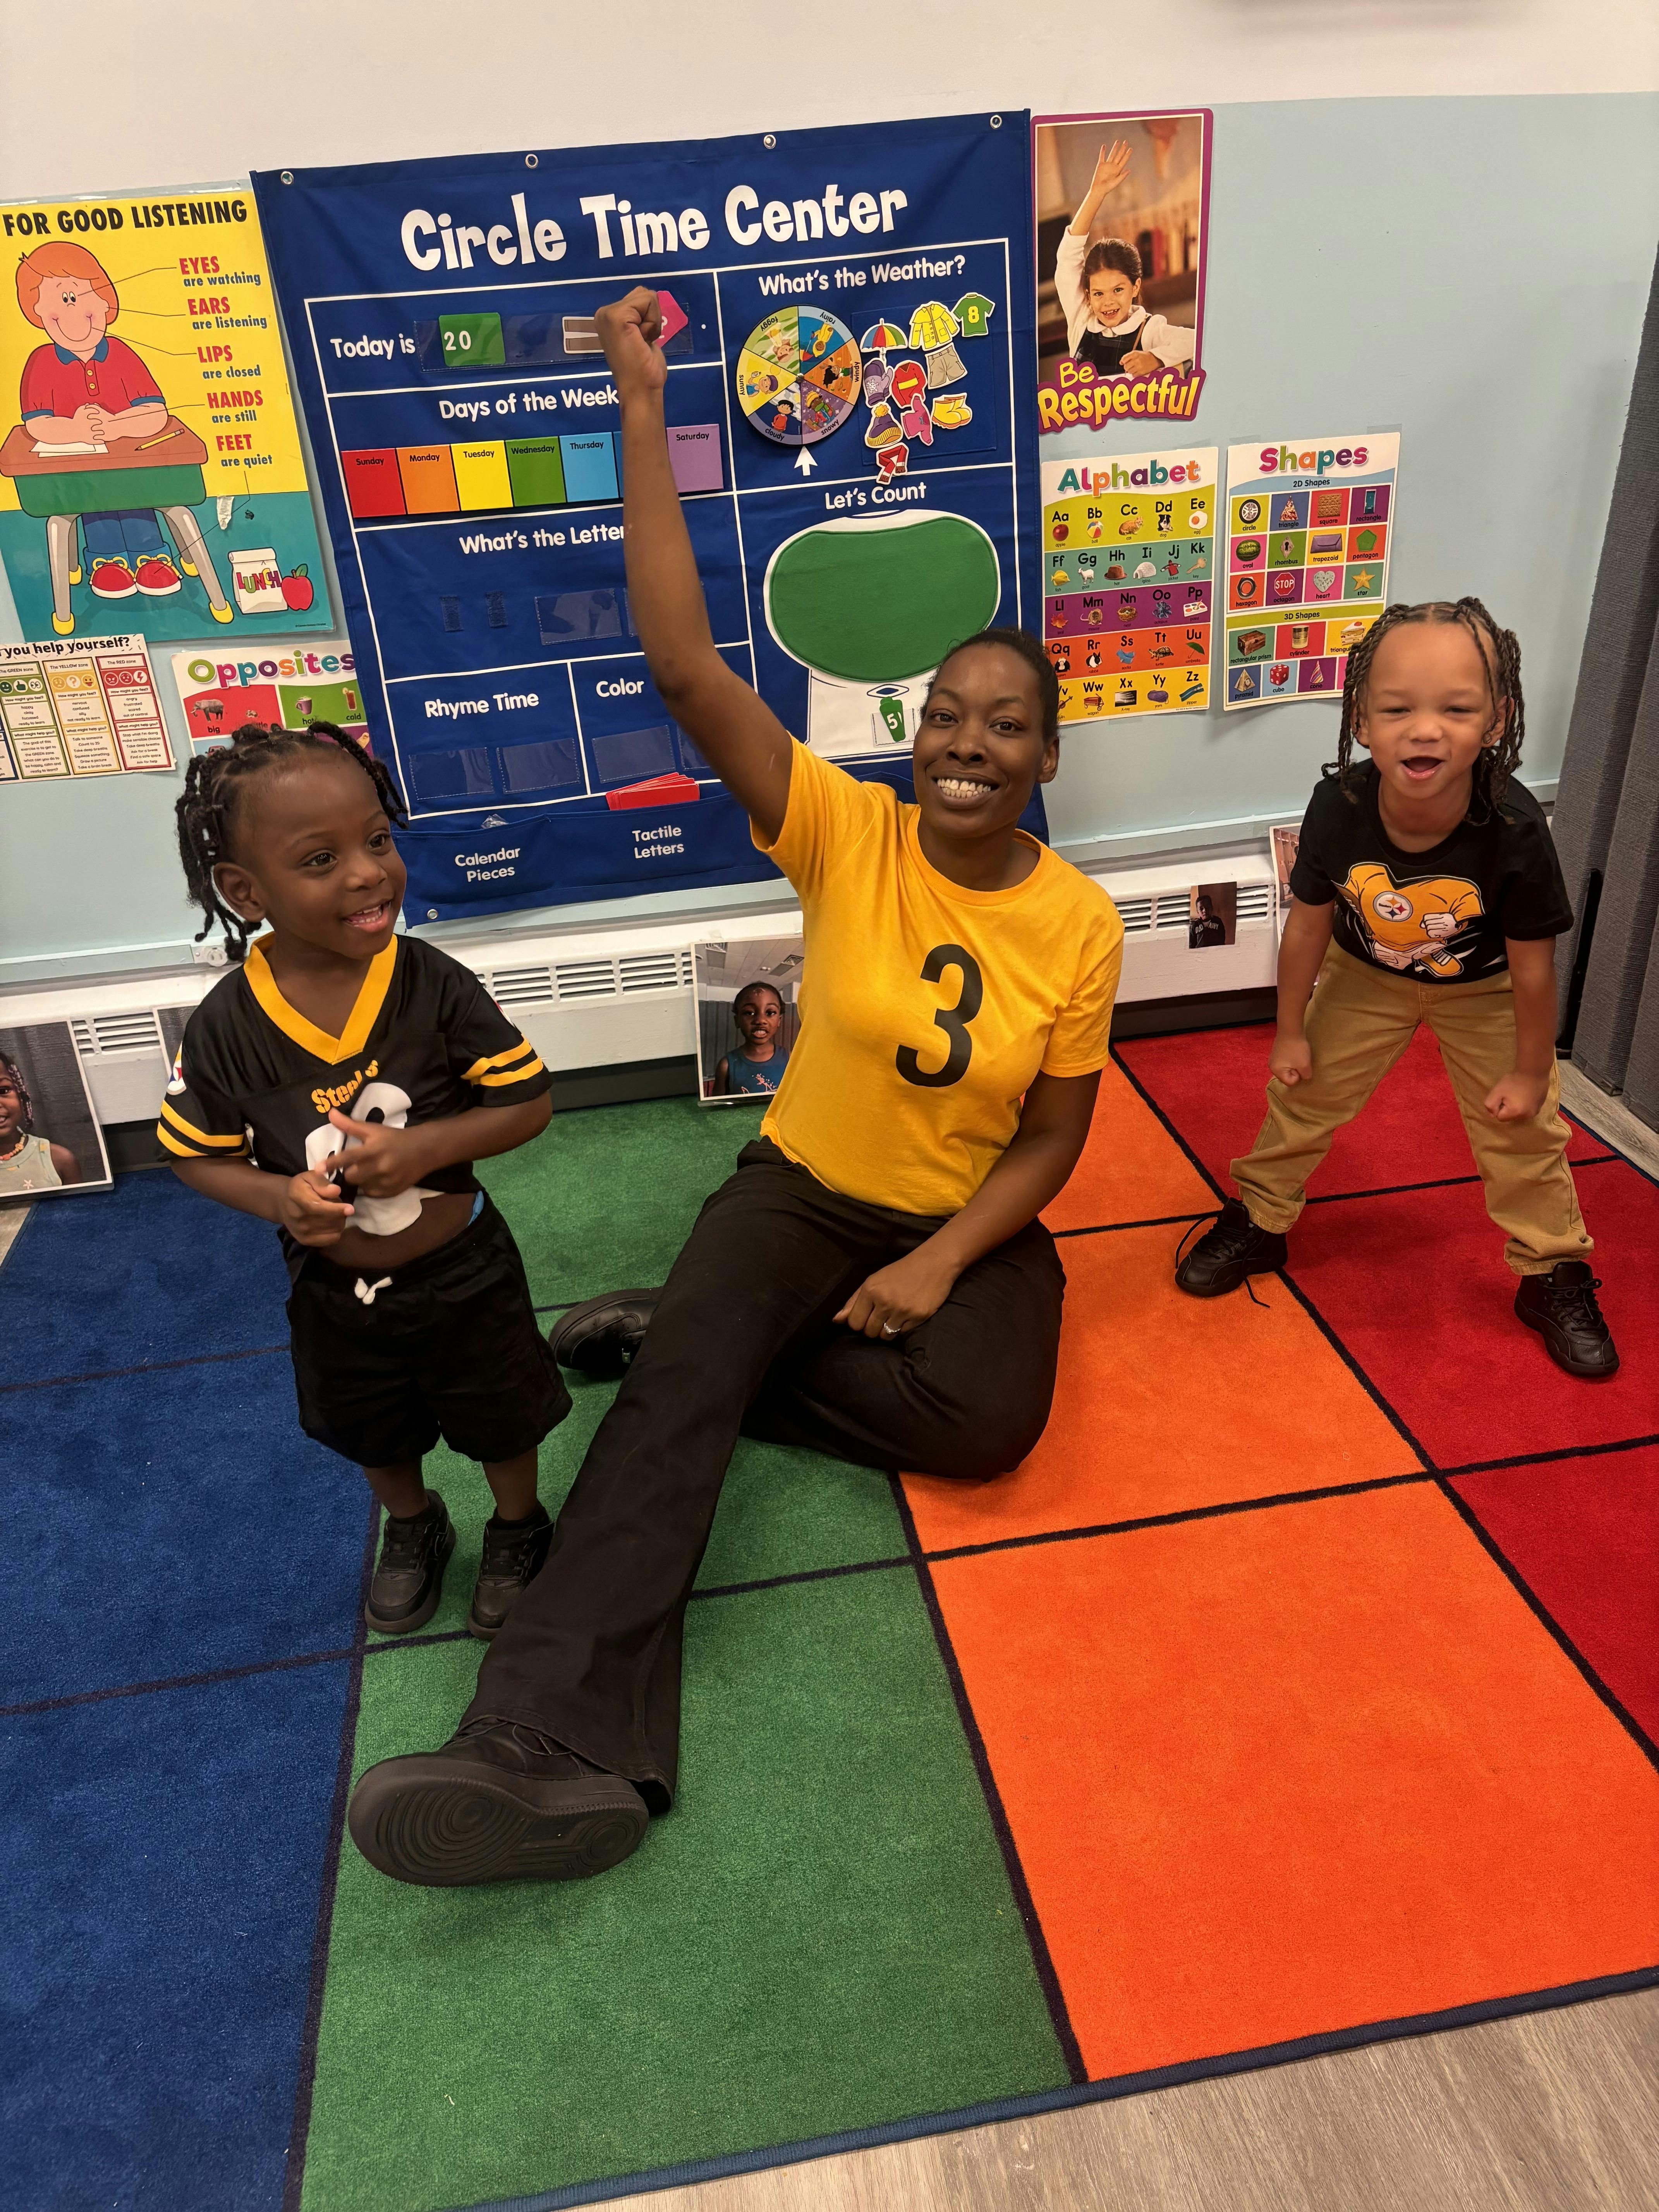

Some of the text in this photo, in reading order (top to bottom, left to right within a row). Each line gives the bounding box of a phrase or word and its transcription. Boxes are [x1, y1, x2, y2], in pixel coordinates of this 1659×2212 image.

[2, 200, 247, 237] FOR GOOD LISTENING
[401, 184, 907, 271] Circle Time Center
[179, 256, 220, 275] EYES
[184, 272, 261, 287] are watching
[758, 255, 966, 297] What's the Weather?
[188, 297, 230, 315] EARS
[820, 312, 836, 325] rainy
[969, 306, 979, 324] 8
[192, 316, 267, 330] are listening
[761, 316, 778, 331] foggy
[330, 334, 415, 360] Today is
[443, 331, 471, 350] 20
[197, 345, 233, 363] LIPS
[203, 365, 261, 379] are closed
[1060, 362, 1095, 388] Be
[208, 390, 263, 409] HANDS
[439, 385, 619, 422] Days of the Week
[1037, 374, 1200, 429] Respectful
[212, 410, 257, 423] are still
[821, 419, 839, 435] snowy
[675, 431, 709, 441] Saturday
[765, 428, 784, 441] cloudy
[216, 434, 252, 452] FEET
[511, 445, 555, 455] Wednesday
[569, 440, 604, 450] Thursday
[409, 453, 440, 463] Monday
[463, 449, 495, 459] Tuesday
[1259, 445, 1367, 474] Shapes
[221, 455, 272, 468] are quiet
[356, 457, 384, 466] Sunday
[1058, 460, 1200, 496] Alphabet
[825, 482, 927, 509] Let's Count
[1121, 504, 1138, 515] Cc
[1156, 500, 1172, 513] Dd
[1191, 498, 1205, 510] Ee
[1052, 511, 1069, 522] Aa
[1088, 507, 1102, 519] Bb
[459, 530, 528, 554] What's
[533, 529, 565, 547] the
[1191, 543, 1205, 554] Kk
[1109, 550, 1125, 561] Hh
[1142, 547, 1151, 558] Ii
[1169, 545, 1179, 559] Jj
[1053, 555, 1065, 567] Ff
[1078, 553, 1097, 567] Gg
[236, 568, 282, 593] LUNCH
[1275, 580, 1294, 589] STOP
[1121, 592, 1136, 604] Nn
[1152, 589, 1171, 601] Oo
[1188, 587, 1202, 600] Pp
[1084, 596, 1103, 608] Mm
[1121, 635, 1133, 646] Ss
[1155, 632, 1166, 643] Tt
[1187, 629, 1202, 640] Uu
[4, 647, 30, 658] you
[33, 642, 64, 654] help
[67, 637, 129, 653] yourself?
[1052, 643, 1070, 656] Qq
[1088, 640, 1100, 650] Rr
[1231, 656, 1257, 664] rectangular
[188, 650, 355, 687] Opposites
[1120, 678, 1132, 688] Xx
[1153, 674, 1166, 688] Yy
[1187, 671, 1199, 682] Zz
[596, 678, 644, 697] Color
[1083, 682, 1103, 693] Ww
[1235, 691, 1253, 699] pyramid
[425, 692, 539, 719] Rhyme Time
[887, 713, 898, 729] 5
[632, 825, 682, 842] Tactile
[454, 846, 520, 867] Calendar
[634, 842, 684, 859] Letters
[467, 866, 515, 883] Pieces
[896, 944, 983, 1087] 3
